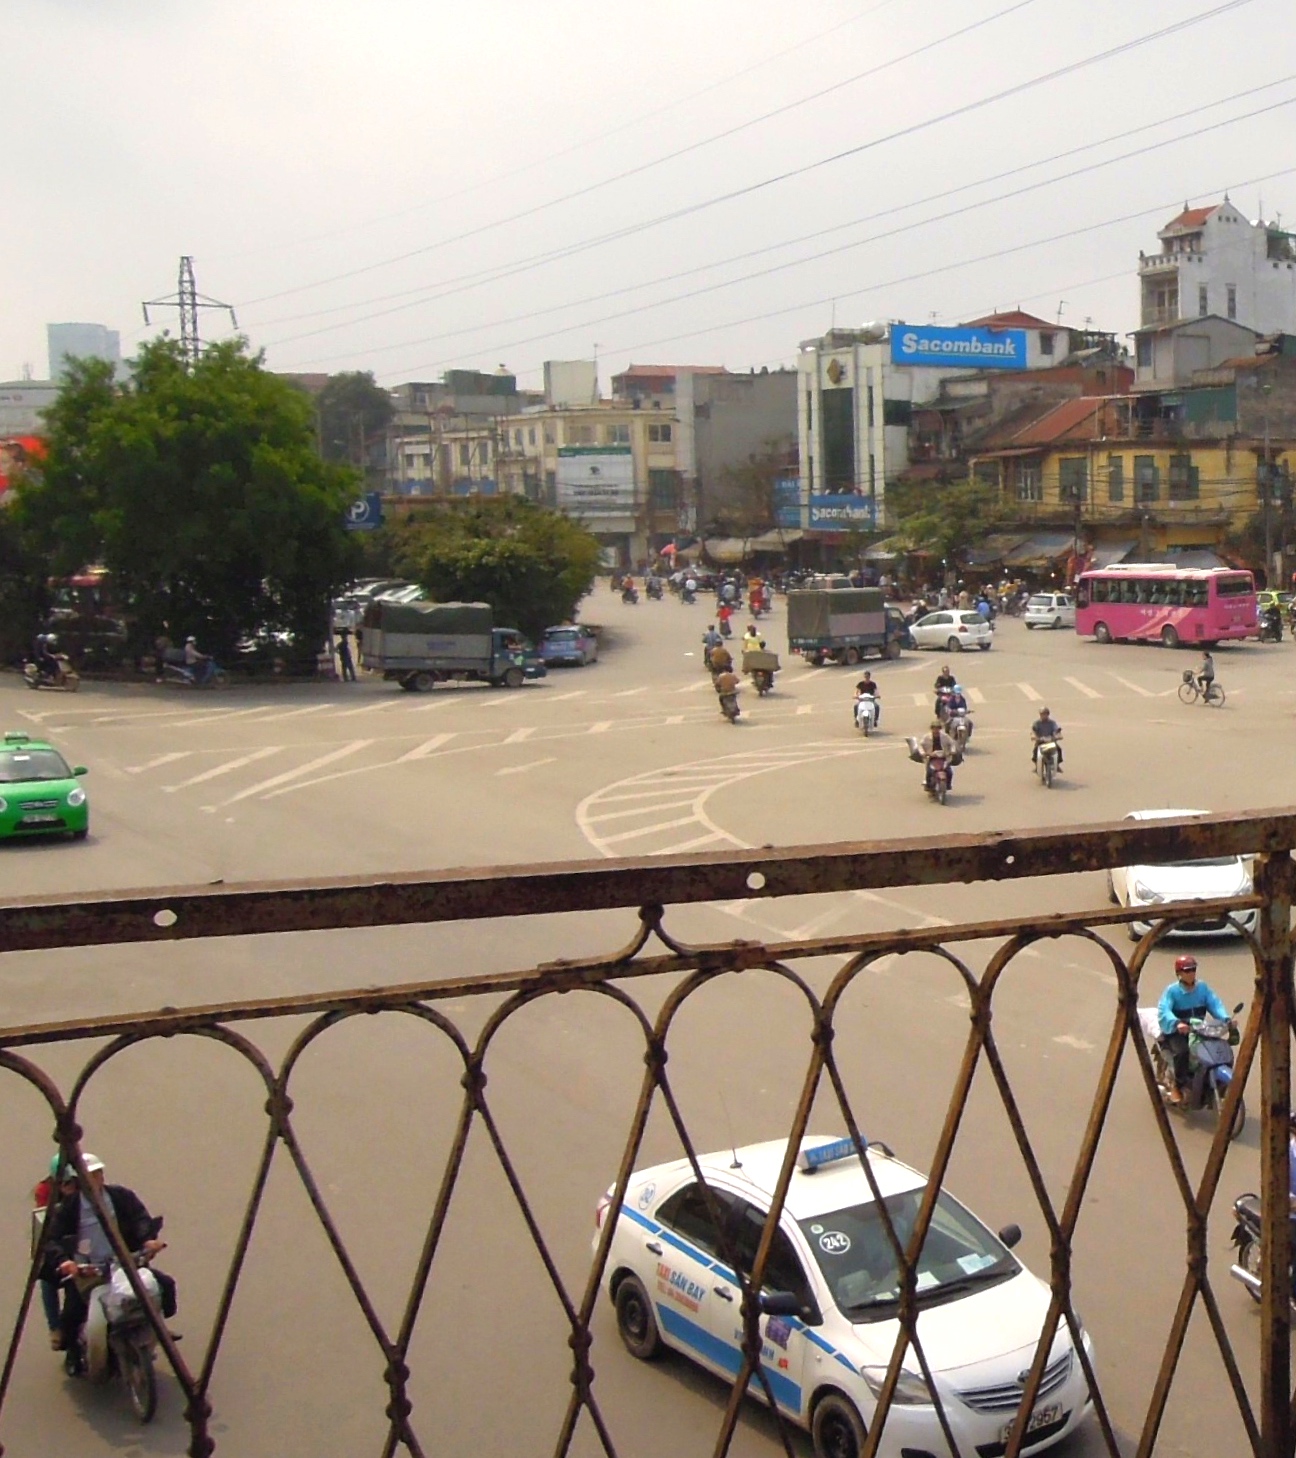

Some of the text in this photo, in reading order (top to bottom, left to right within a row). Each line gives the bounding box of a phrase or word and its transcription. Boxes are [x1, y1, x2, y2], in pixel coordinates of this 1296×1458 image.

[902, 332, 1016, 355] Sacombank
[351, 501, 365, 520] P
[822, 1234, 847, 1250] 242
[686, 1281, 706, 1302] BAY
